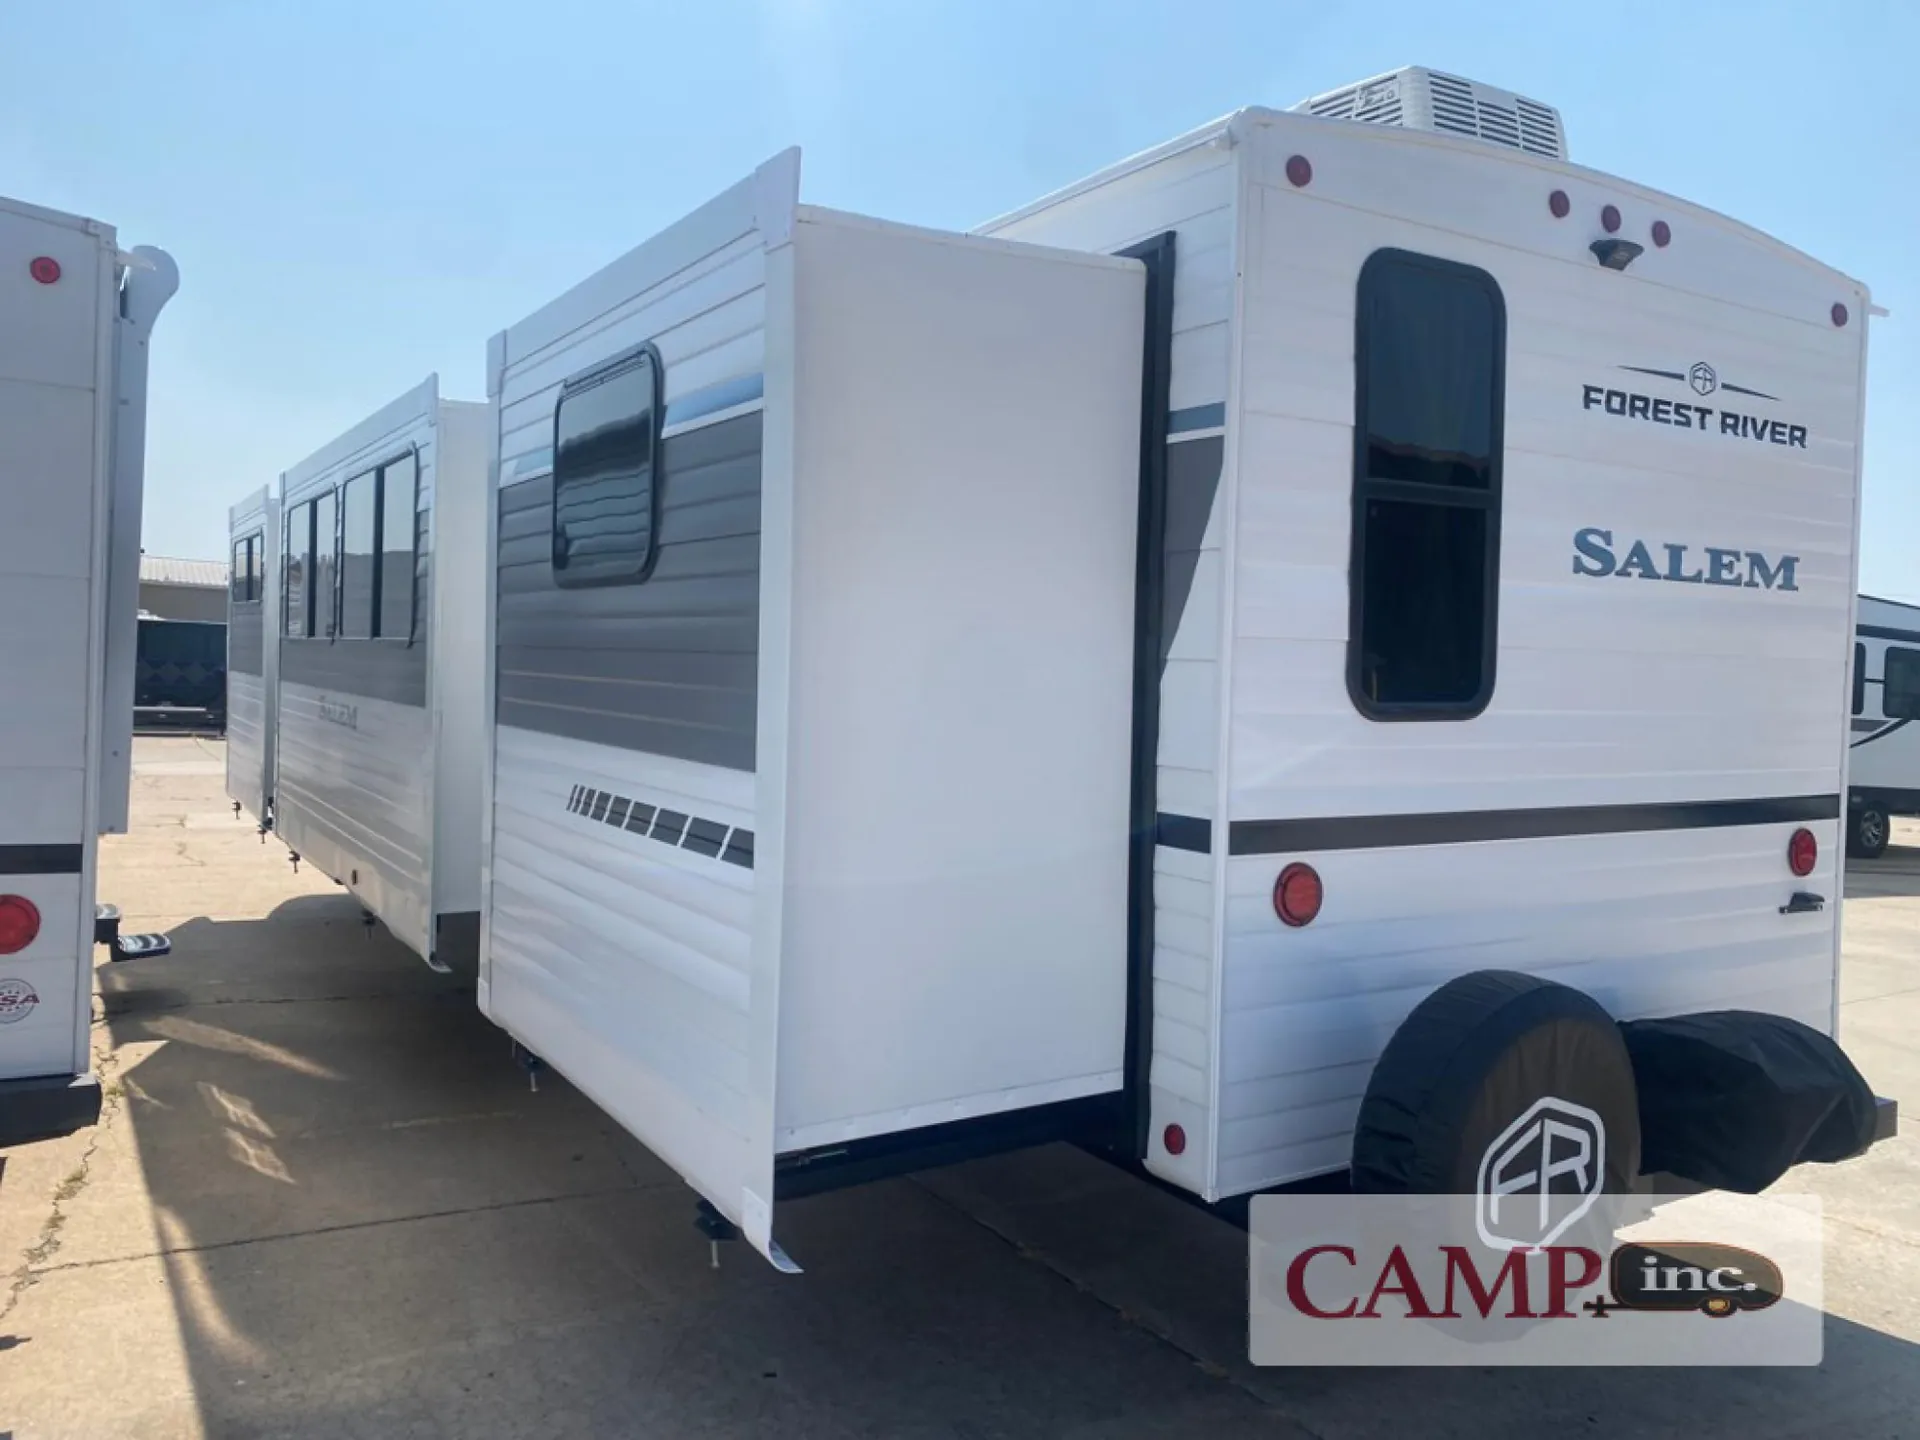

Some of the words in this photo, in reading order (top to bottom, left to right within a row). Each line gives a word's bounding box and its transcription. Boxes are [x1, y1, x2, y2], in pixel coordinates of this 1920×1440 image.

[1582, 384, 1713, 431] FOREST
[1720, 410, 1807, 449] RIVER
[1572, 527, 1800, 592] SALEM
[0, 993, 40, 1006] SA
